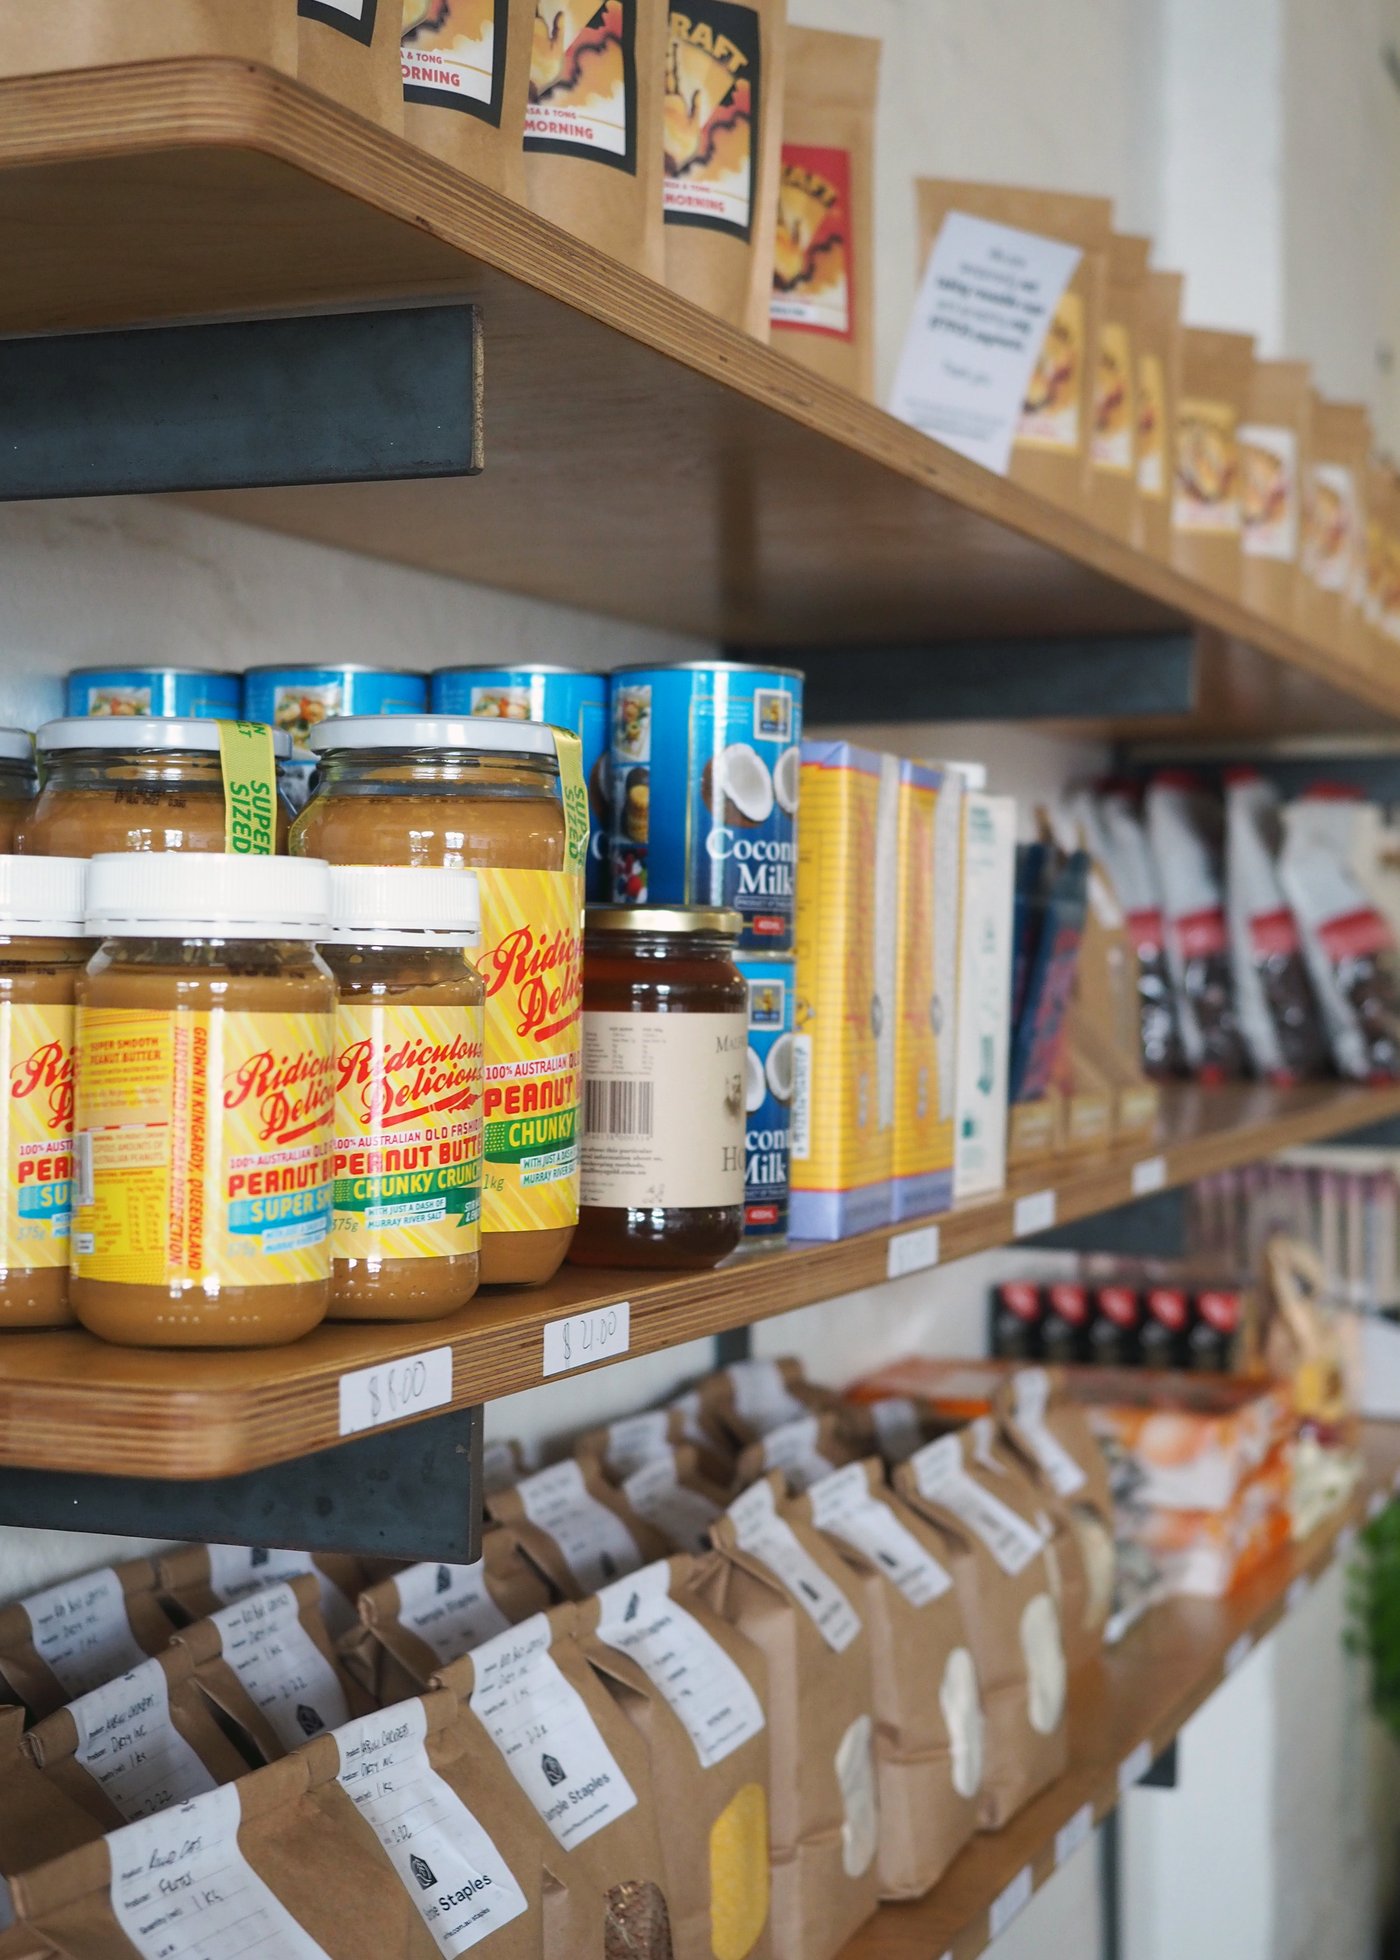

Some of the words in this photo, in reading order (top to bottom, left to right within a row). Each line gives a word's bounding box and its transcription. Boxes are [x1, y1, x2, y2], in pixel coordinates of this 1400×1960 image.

[671, 11, 749, 74] RAFT
[416, 53, 442, 64] TONG
[524, 119, 594, 140] MORNING
[553, 110, 577, 120] TONG
[230, 780, 252, 855] SIZED
[564, 786, 579, 861] SIZED
[192, 1027, 207, 1075] GROWN
[335, 1033, 482, 1092] Ridiculous
[486, 1065, 512, 1080] 100%
[515, 1056, 567, 1077] AUSTRALIAN
[192, 1080, 206, 1094] IN
[483, 1075, 573, 1117] PEANUT
[188, 1100, 206, 1172] KINGAROY,
[358, 1132, 421, 1148] AUSTRALIAN
[425, 1126, 448, 1141] OLD
[509, 1112, 574, 1148] CHUNKY
[20, 1144, 44, 1156] 100%
[334, 1145, 432, 1176] PEANUT
[523, 1157, 540, 1169] WITH
[228, 1162, 318, 1197] PEANUT
[353, 1171, 433, 1199] CHUNKY
[483, 1173, 504, 1191] 1kg
[523, 1169, 552, 1185] MURRAY
[169, 1176, 186, 1265] PERFECTION
[251, 1193, 313, 1223] SUPER
[389, 1203, 407, 1216] JUST
[409, 1203, 414, 1212] A
[416, 1200, 434, 1211] DASH
[435, 1199, 444, 1208] OF
[403, 1215, 425, 1225] RIVER
[427, 1211, 442, 1221] SALT
[187, 1178, 204, 1270] QUEENSLAND
[568, 1773, 611, 1804] Staples
[438, 1874, 492, 1911] Staples
